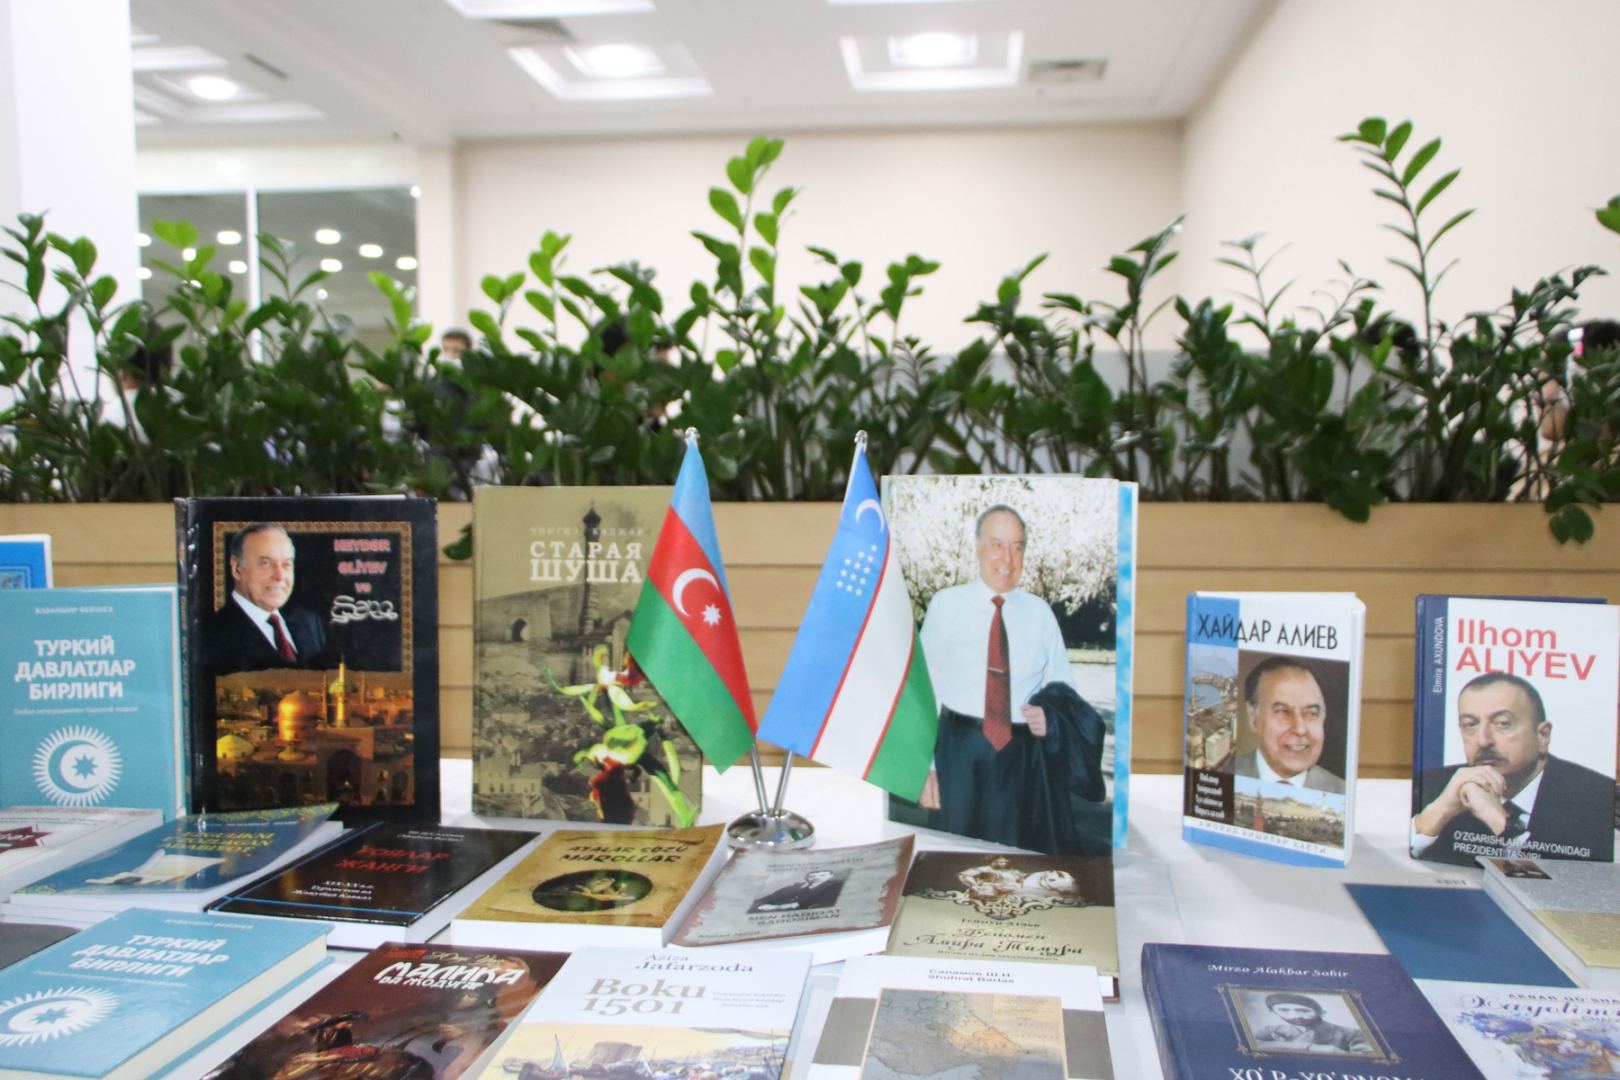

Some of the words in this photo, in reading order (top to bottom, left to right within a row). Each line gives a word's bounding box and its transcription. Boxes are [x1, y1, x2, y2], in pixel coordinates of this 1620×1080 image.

[333, 539, 392, 552] HEYDƏR
[529, 540, 643, 560] СТАРАЯ
[337, 559, 388, 575] ƏLİYEV
[529, 559, 642, 583] ШУША
[1197, 613, 1272, 643] ХАЙДАР
[1277, 623, 1339, 650] АЛИЕВ
[1433, 616, 1445, 665] AXUNDOVA
[1457, 618, 1557, 649] Ilhom
[33, 634, 116, 657] ТУРКИЙ
[14, 659, 136, 682] ДАВЛАТЛАР
[1455, 647, 1597, 681] ALIYEV
[29, 681, 124, 700] БИРЛИГИ
[1432, 668, 1443, 694] Elmira
[1453, 842, 1503, 857] PREZIDENT
[126, 934, 227, 951] ТУРКИЙ
[72, 944, 230, 966] ДАВЛАТЛАР
[645, 954, 689, 962] Aziza
[69, 957, 194, 978] БИРЛИГИ
[373, 961, 526, 985] МАЛИКА
[635, 961, 754, 973] Jafarzoda
[1207, 964, 1250, 973] Mirzo
[1252, 965, 1309, 977] Alakbar
[1311, 969, 1350, 978] Sobir
[584, 977, 708, 999] Boku
[579, 997, 686, 1017] 1501
